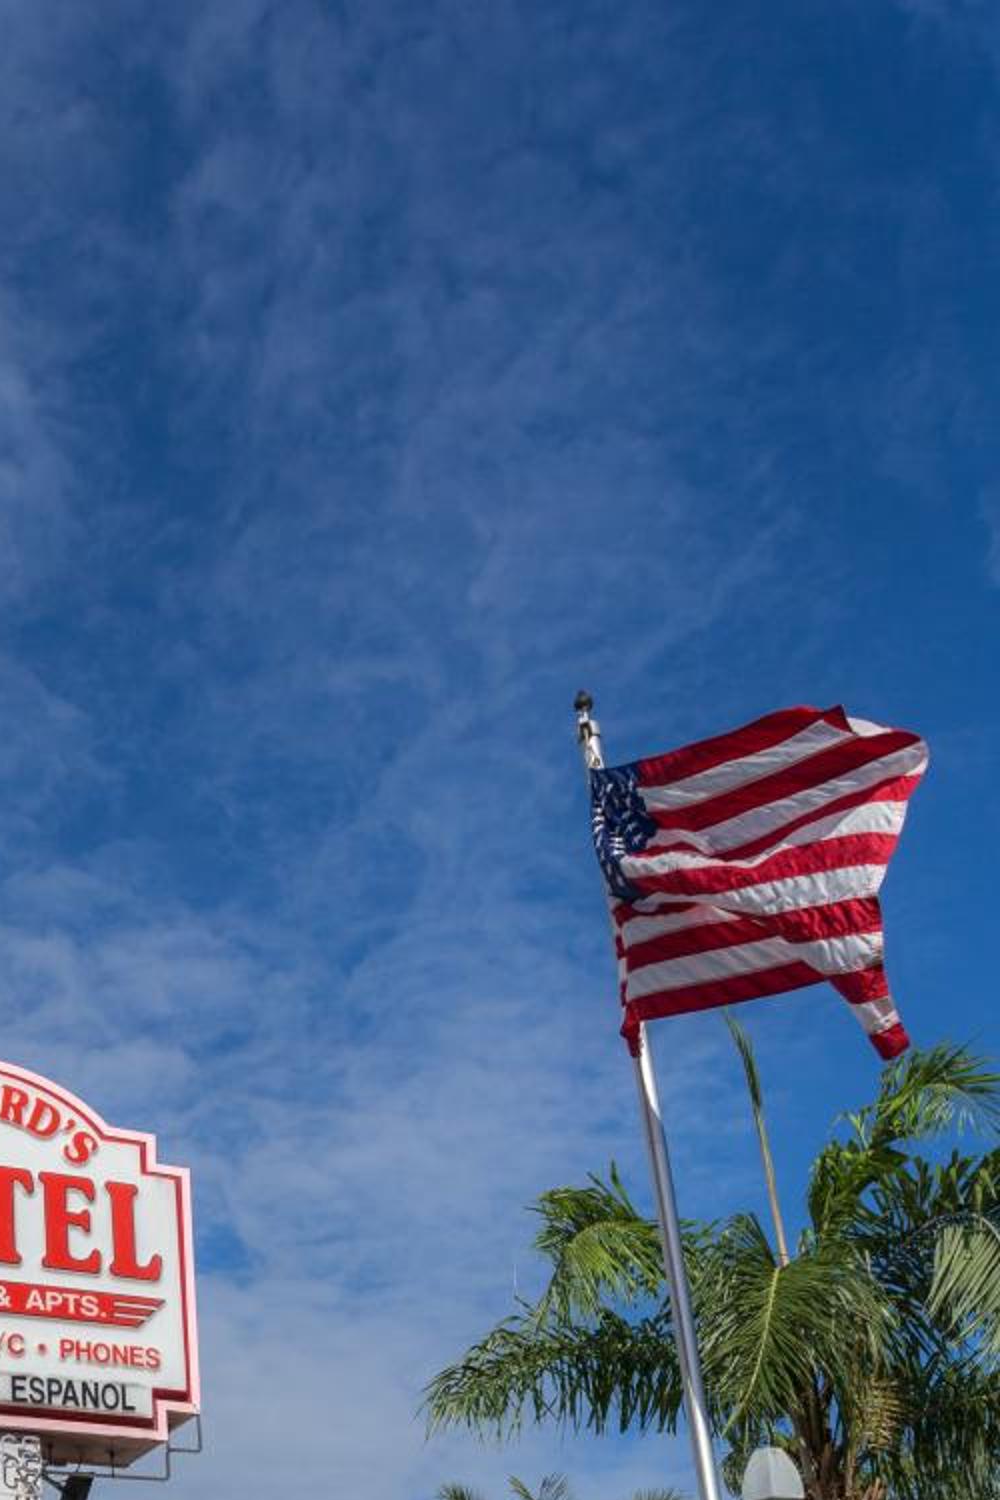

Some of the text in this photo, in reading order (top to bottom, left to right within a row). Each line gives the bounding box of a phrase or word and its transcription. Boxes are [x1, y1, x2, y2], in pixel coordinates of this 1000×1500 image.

[25, 1291, 108, 1319] APTS.
[59, 1338, 162, 1370] PHONES
[10, 1375, 137, 1412] ESPANOL
